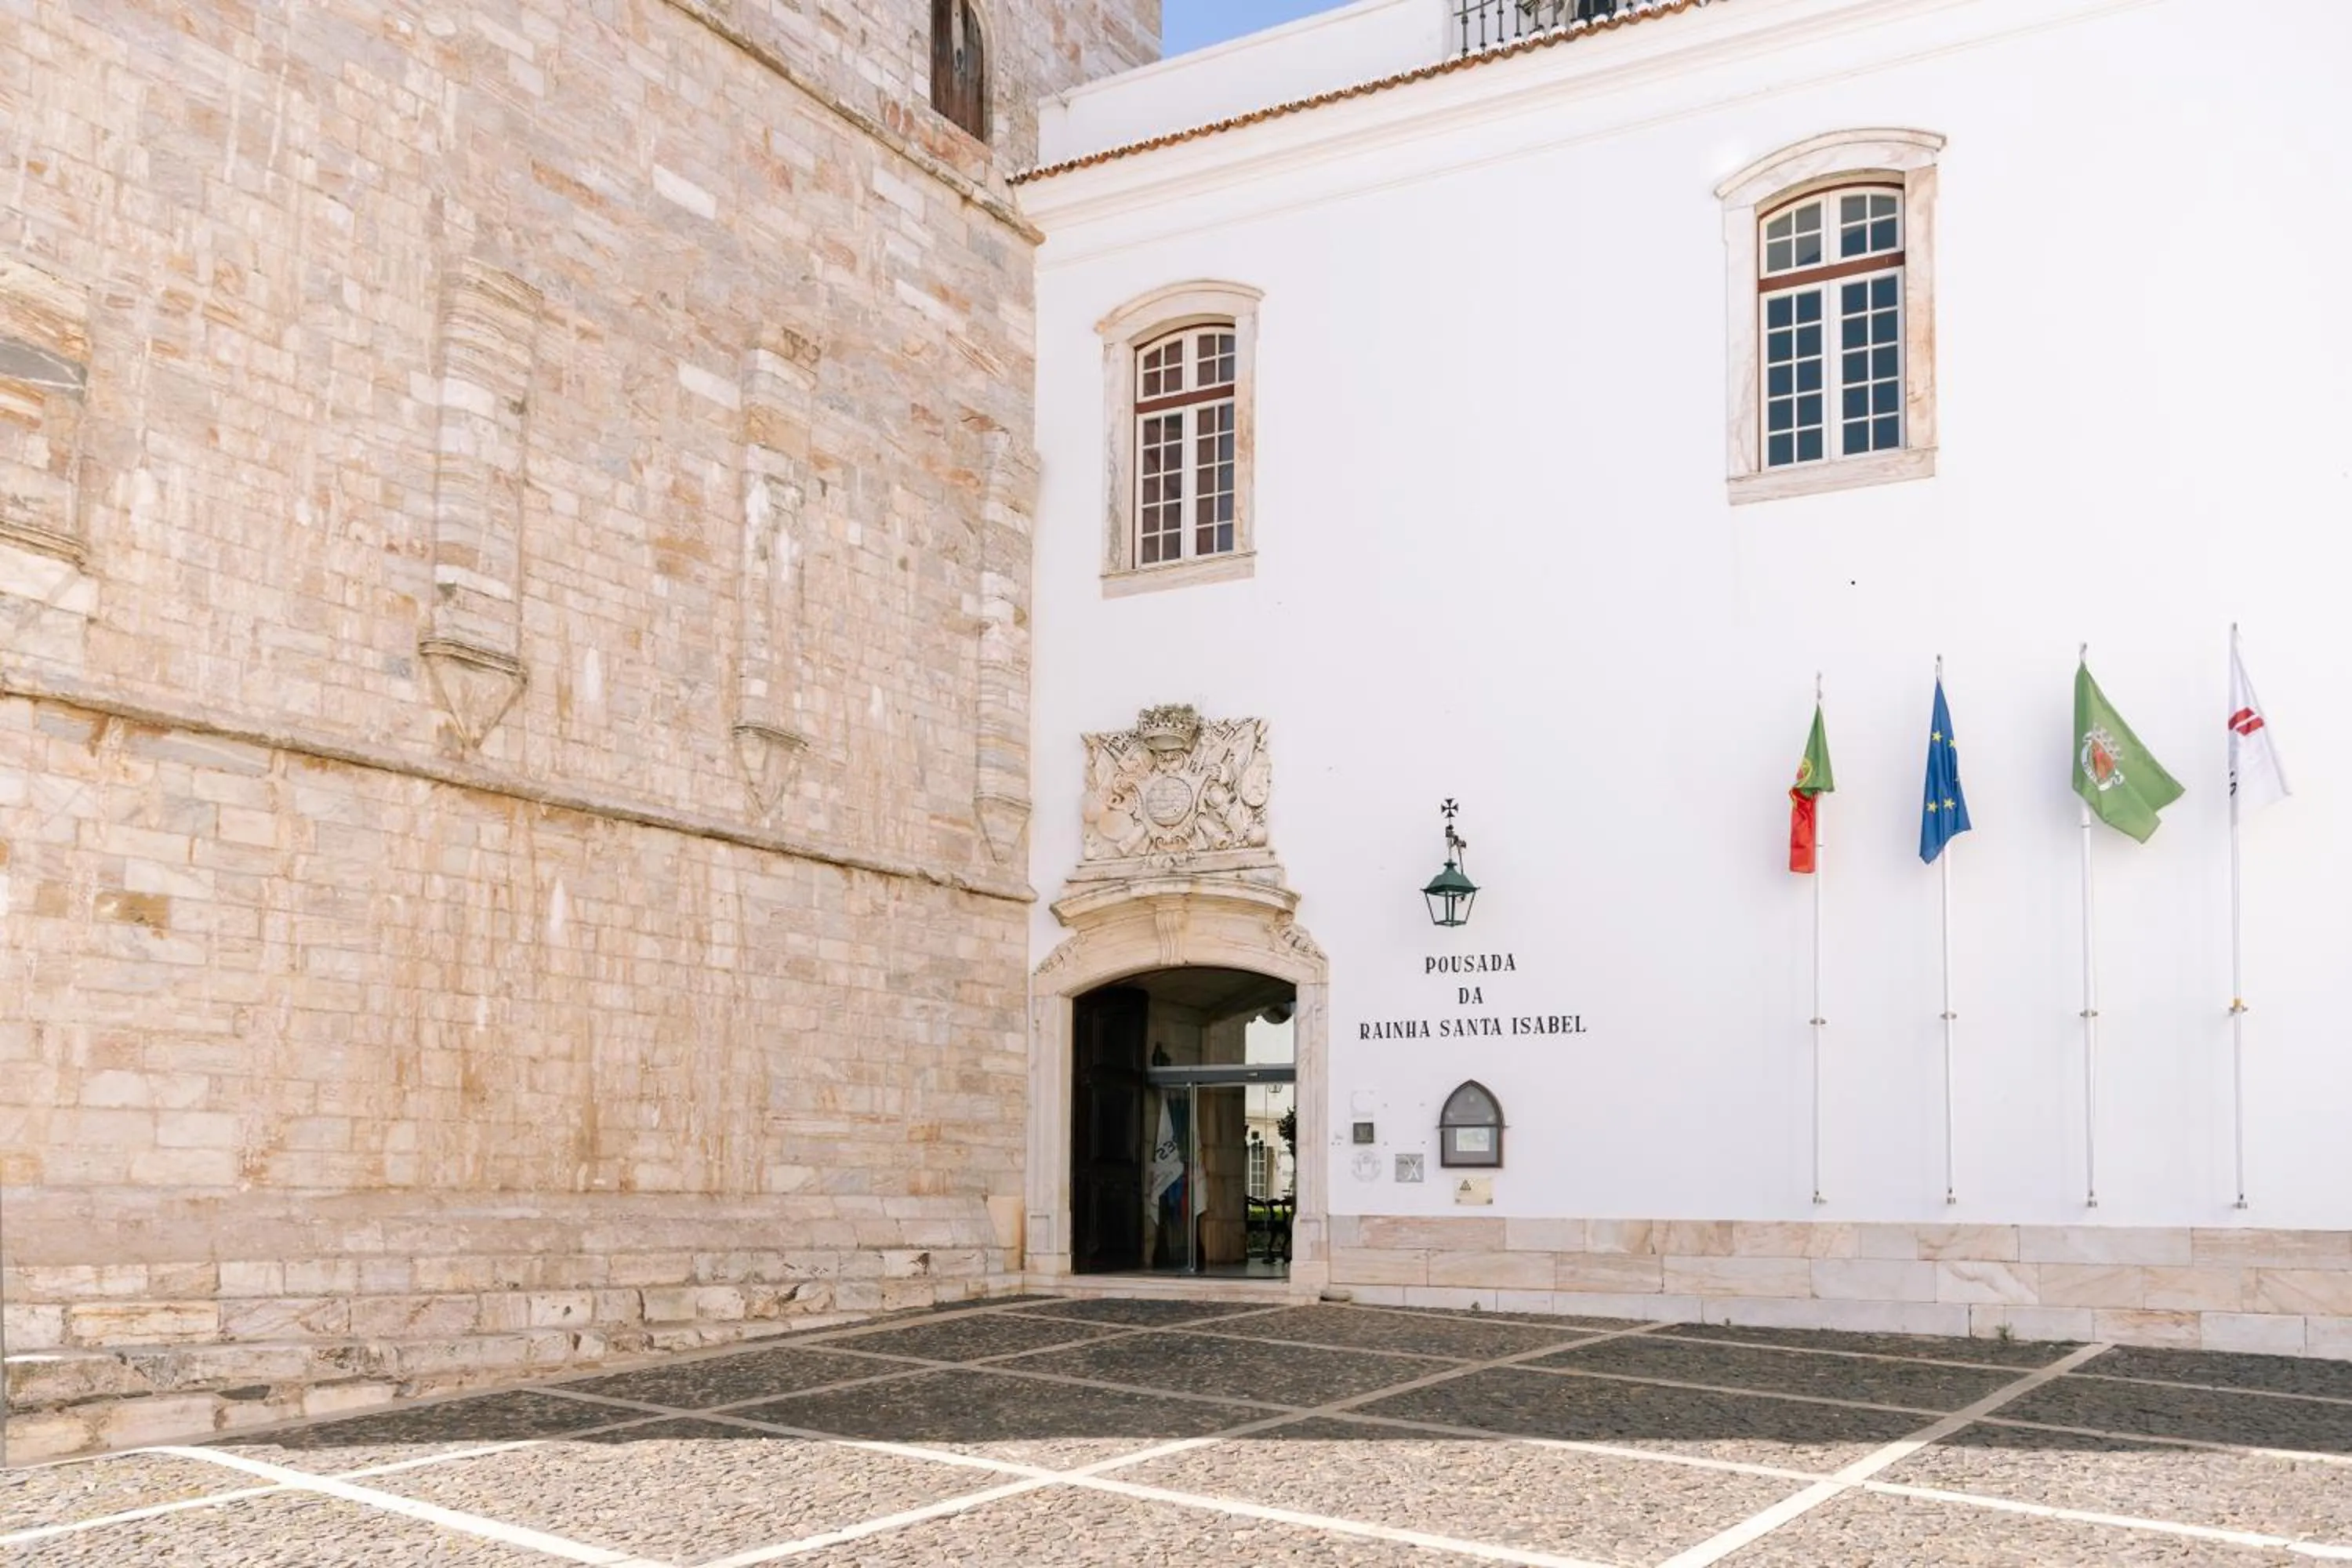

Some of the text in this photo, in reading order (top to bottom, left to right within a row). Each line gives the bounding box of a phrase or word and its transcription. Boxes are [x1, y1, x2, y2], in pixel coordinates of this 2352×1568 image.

[1425, 953, 1516, 975] POUSADA
[1458, 986, 1484, 1005] DA
[1359, 1014, 1587, 1040] RAINHA SANTA ISABEL
